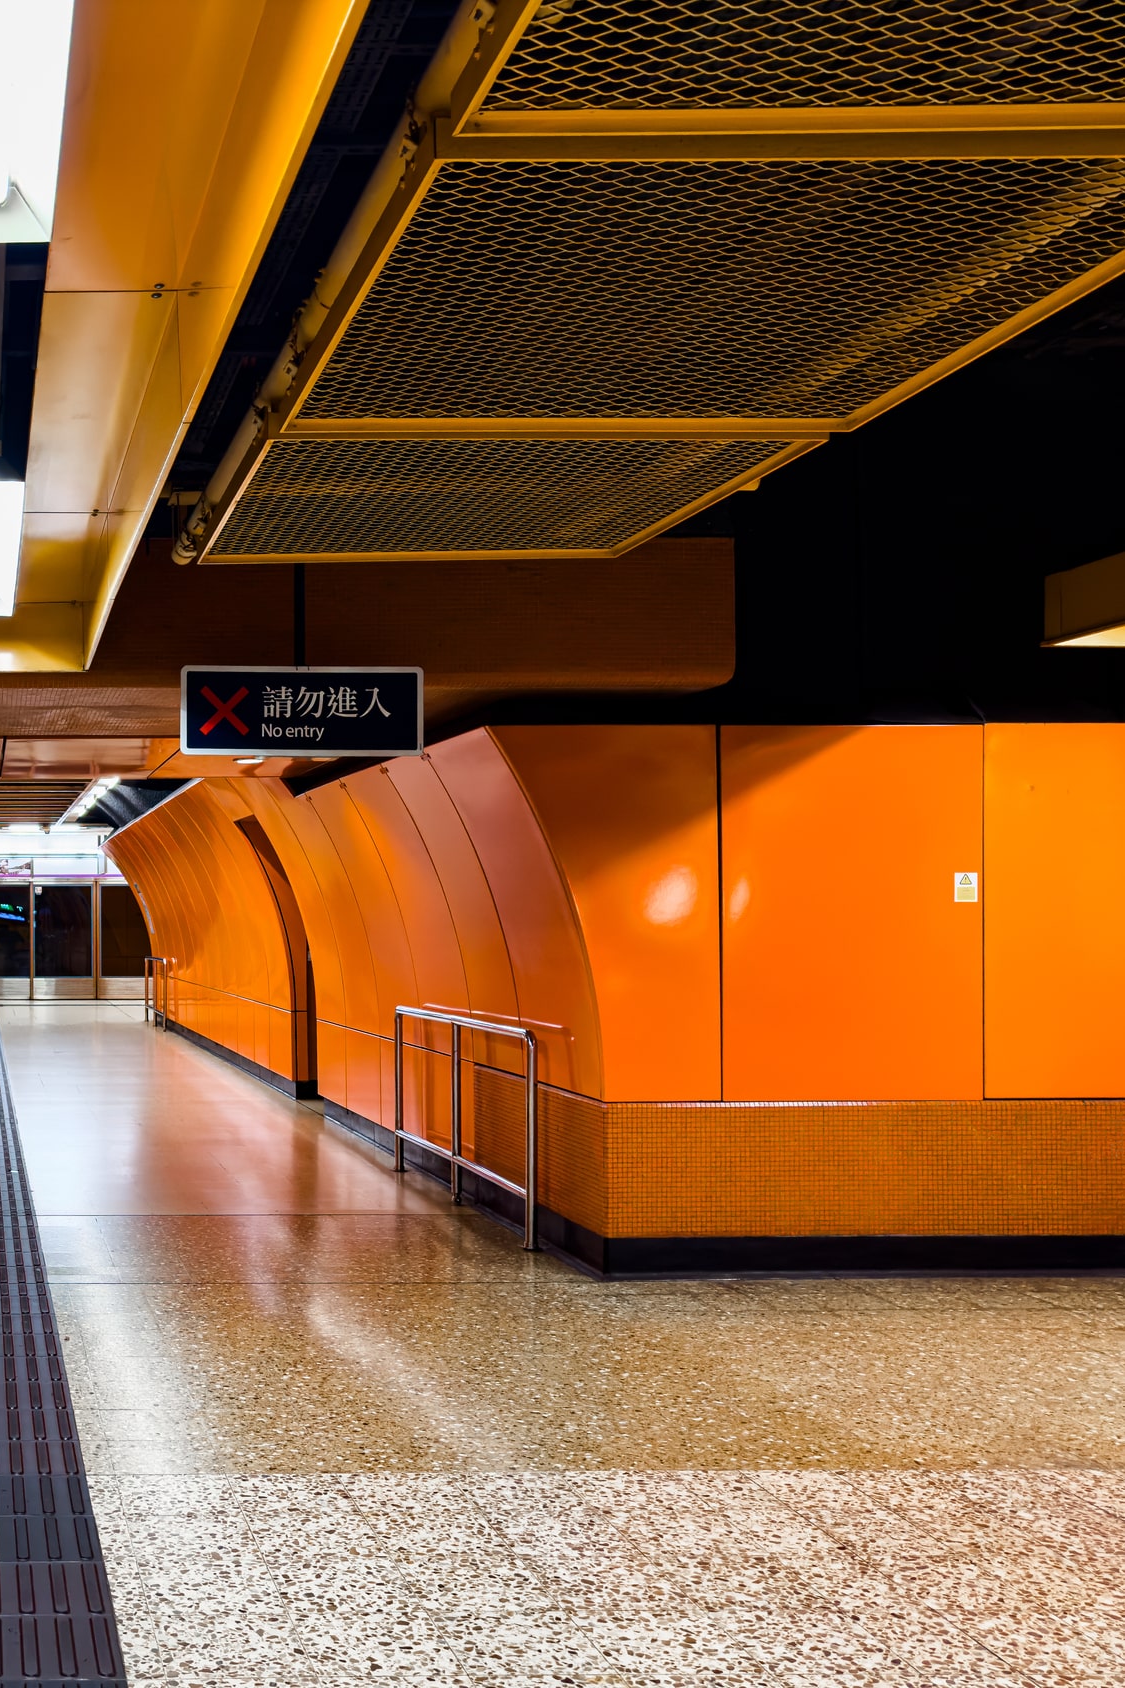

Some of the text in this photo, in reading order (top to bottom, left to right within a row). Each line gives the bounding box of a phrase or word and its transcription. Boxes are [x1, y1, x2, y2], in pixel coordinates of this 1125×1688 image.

[261, 686, 392, 719] 請勿進入
[261, 723, 325, 742] No entry
